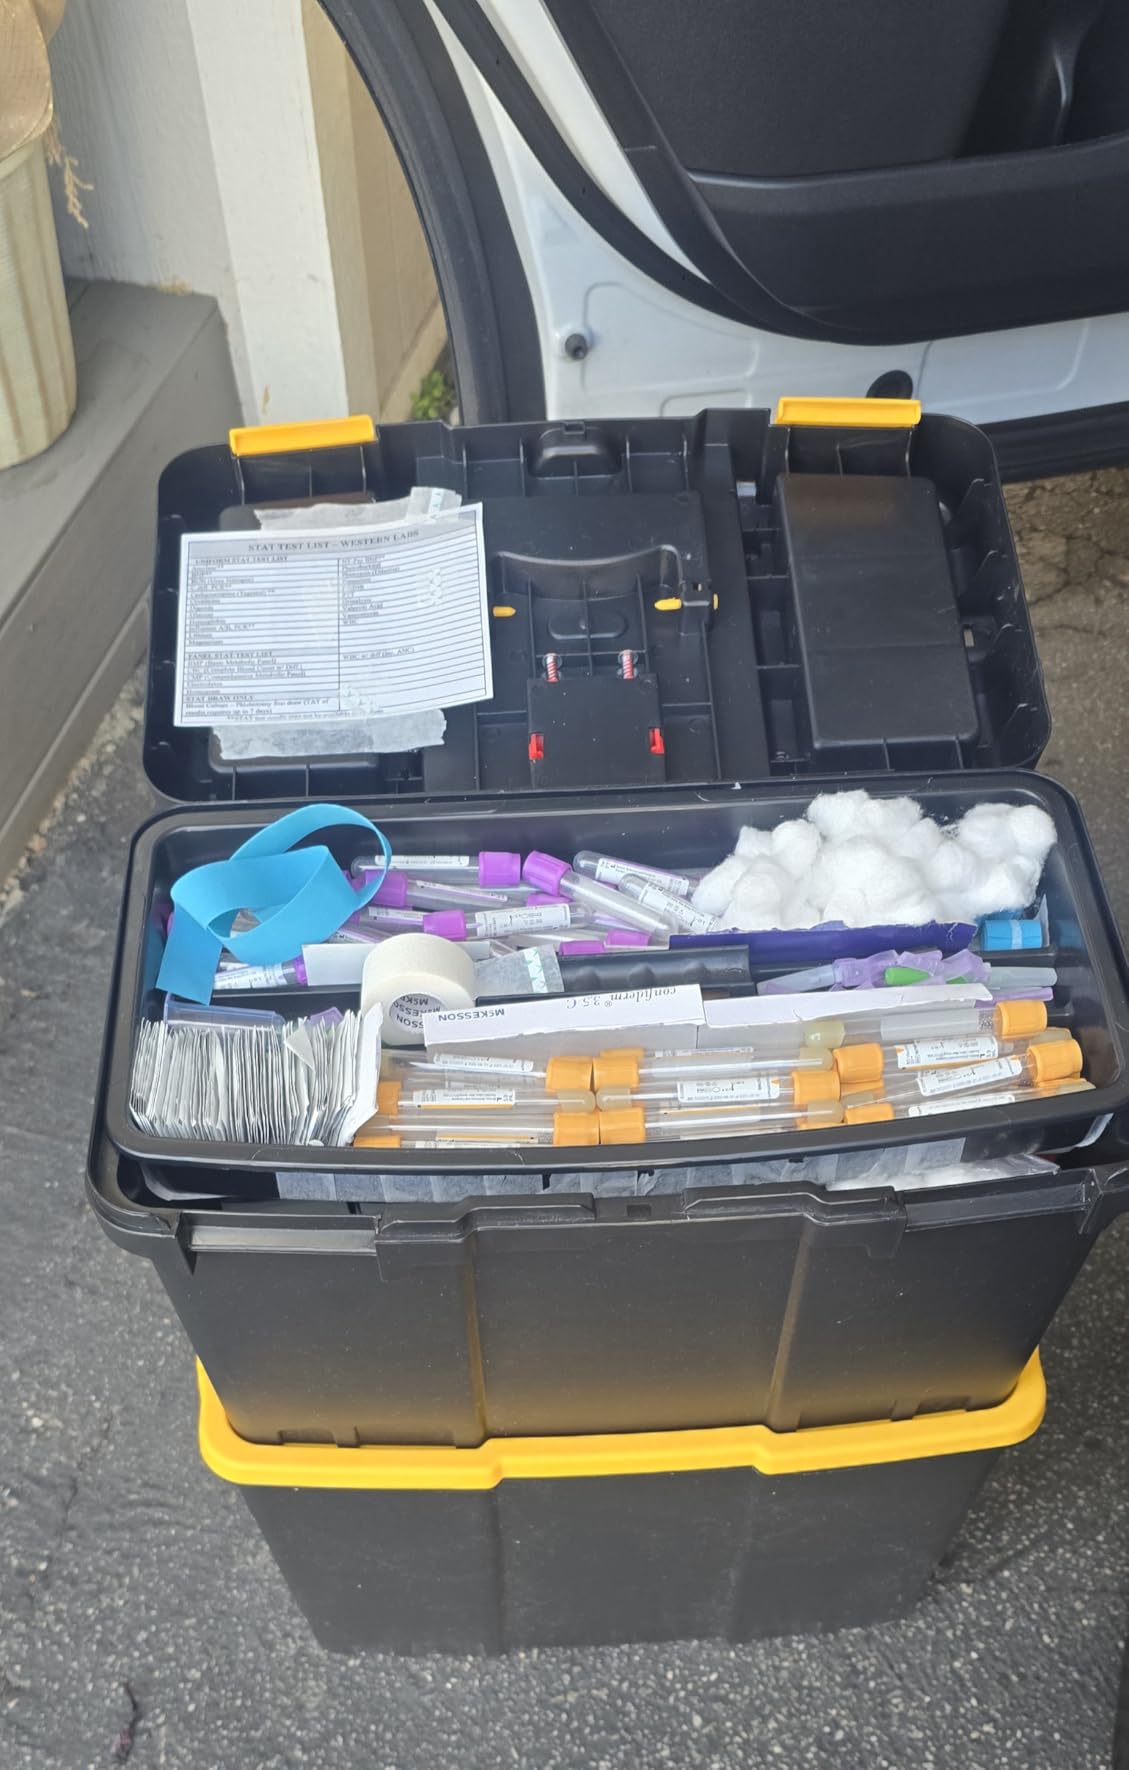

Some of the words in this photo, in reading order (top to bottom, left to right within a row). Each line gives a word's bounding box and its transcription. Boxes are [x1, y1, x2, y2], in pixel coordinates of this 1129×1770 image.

[247, 543, 274, 551] STAT
[279, 542, 304, 551] TEST
[307, 541, 329, 550] LIST
[340, 536, 390, 548] WESTERN
[392, 529, 419, 541] LABS
[566, 996, 578, 1009] C
[396, 1013, 424, 1029] SSON
[438, 1008, 505, 1022] McKESSON
